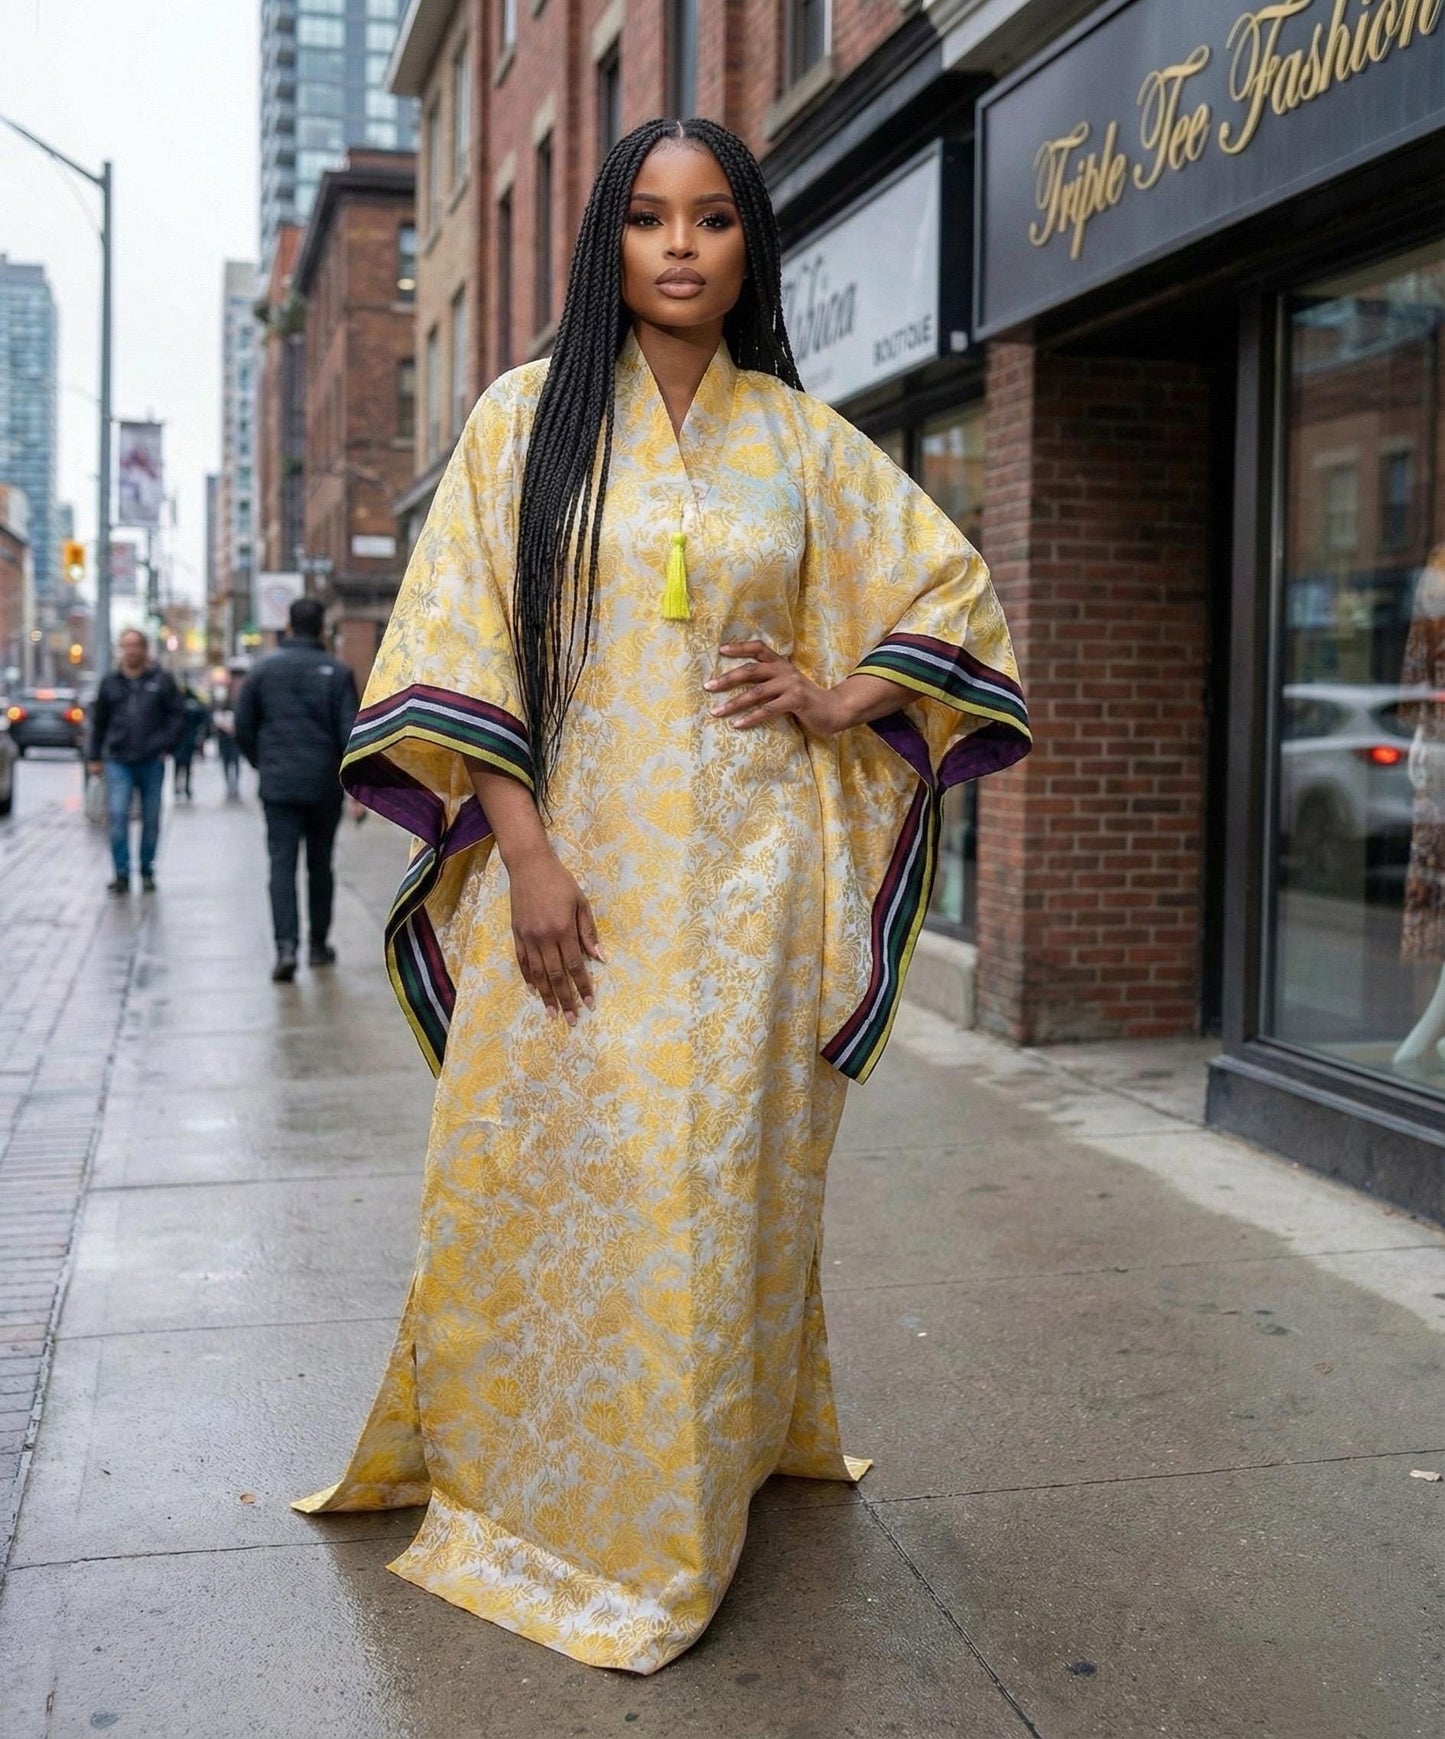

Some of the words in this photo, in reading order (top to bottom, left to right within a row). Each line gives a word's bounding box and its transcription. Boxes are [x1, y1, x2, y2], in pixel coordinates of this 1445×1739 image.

[1029, 120, 1126, 260] Triple
[1133, 44, 1211, 190] Tee
[1219, 0, 1443, 154] Fashion
